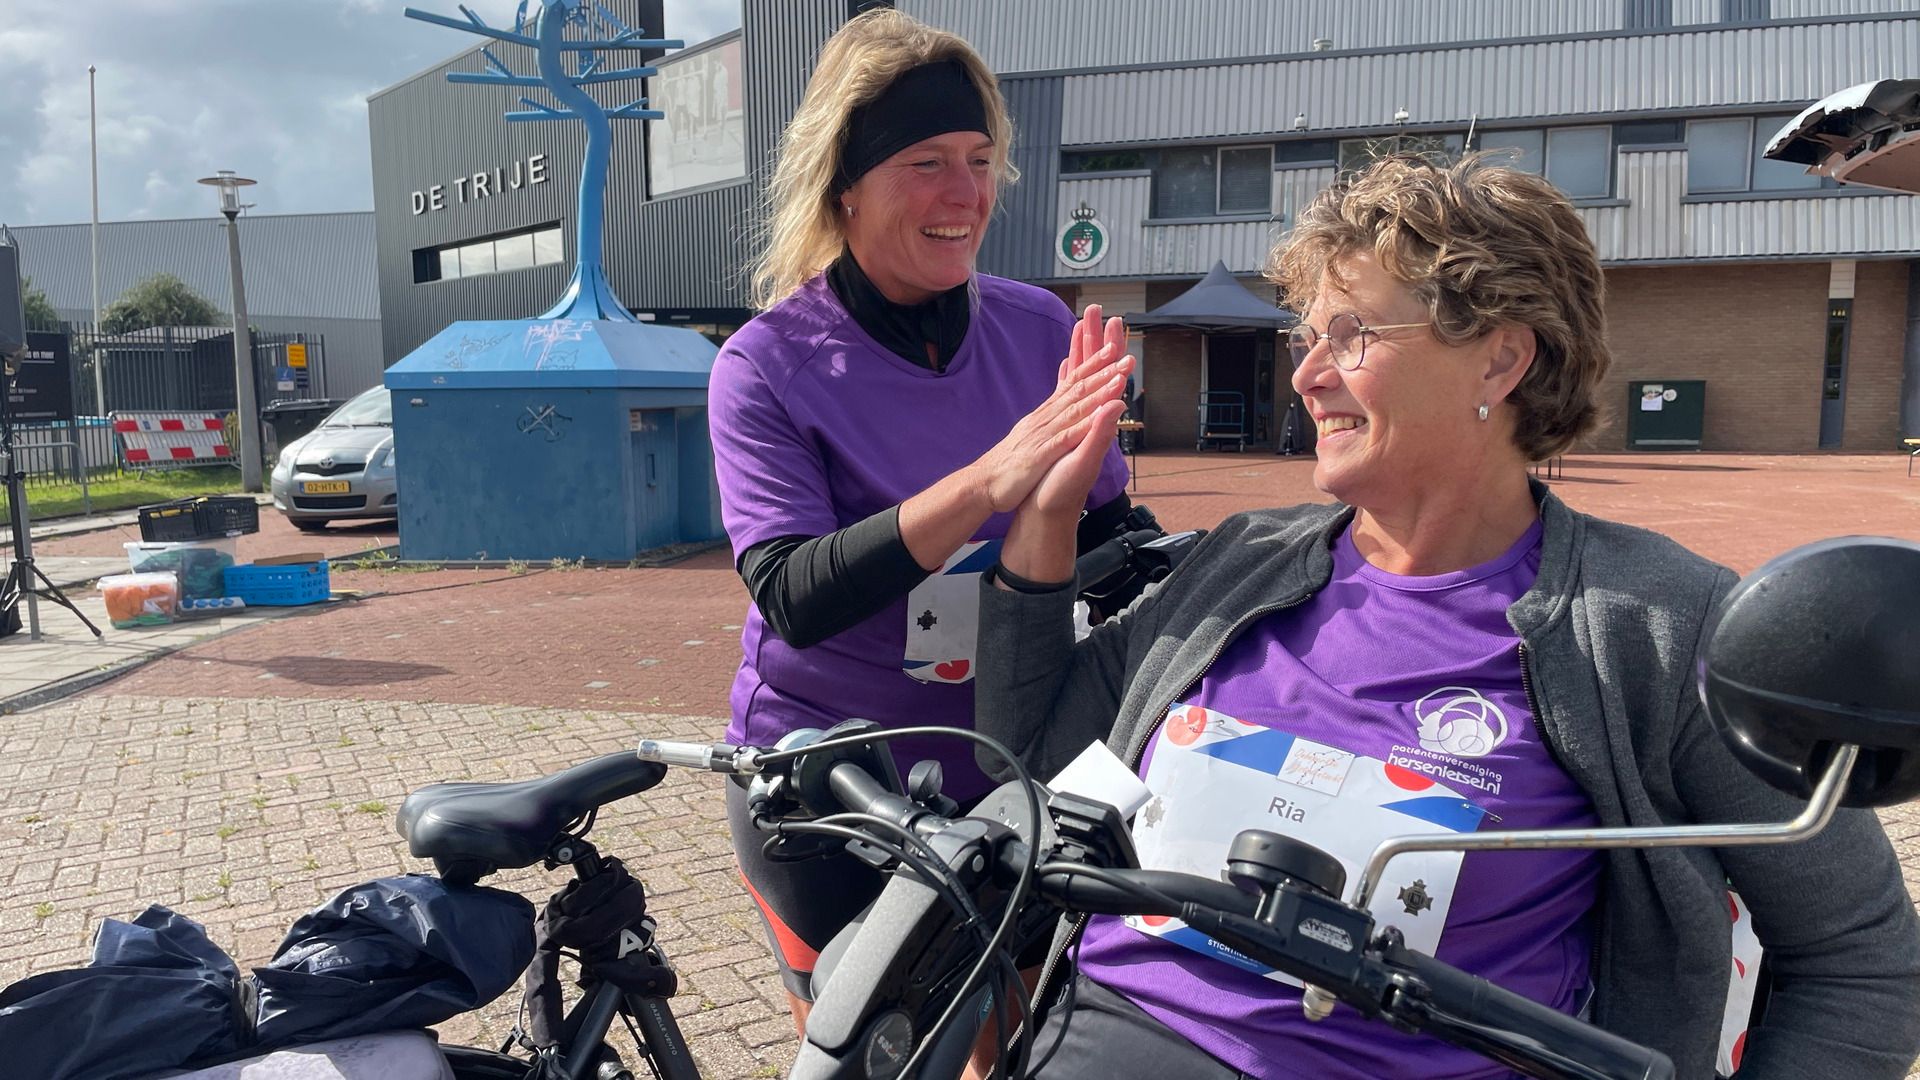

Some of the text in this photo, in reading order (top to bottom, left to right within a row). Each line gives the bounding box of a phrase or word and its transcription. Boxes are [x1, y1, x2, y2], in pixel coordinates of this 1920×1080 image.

[412, 154, 546, 215] DE TRIJE
[307, 481, 346, 493] 02-HTK-1
[1268, 796, 1305, 823] Ria
[650, 1003, 677, 1056] GAZELLE VENTO
